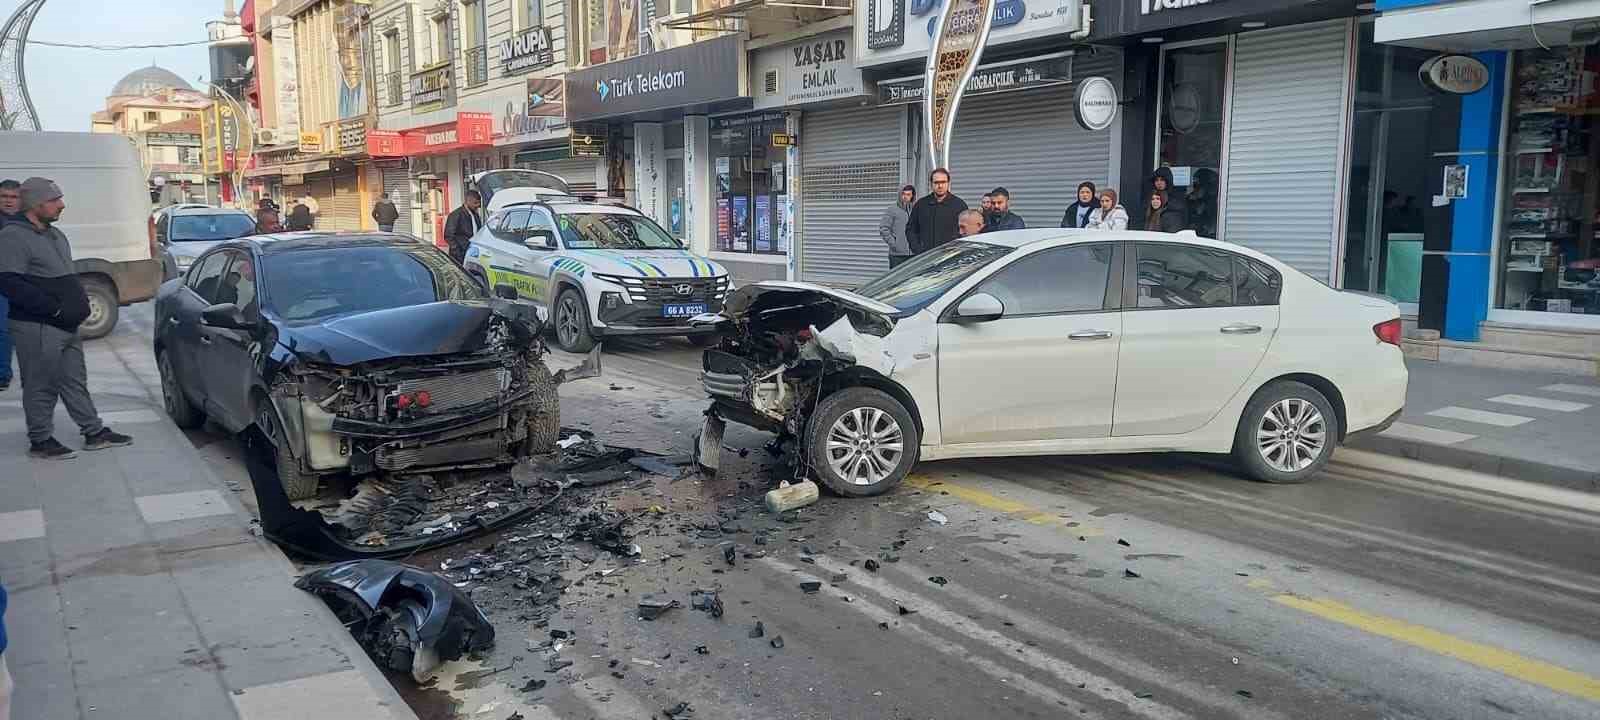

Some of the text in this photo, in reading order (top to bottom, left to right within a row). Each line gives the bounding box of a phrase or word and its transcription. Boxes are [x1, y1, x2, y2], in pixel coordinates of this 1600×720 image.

[499, 30, 547, 60] AVRUPA
[793, 40, 846, 69] YAŞAR
[611, 70, 685, 98] Türk Telekom
[802, 69, 836, 89] EMLAK
[667, 305, 703, 314] 66 A 8232
